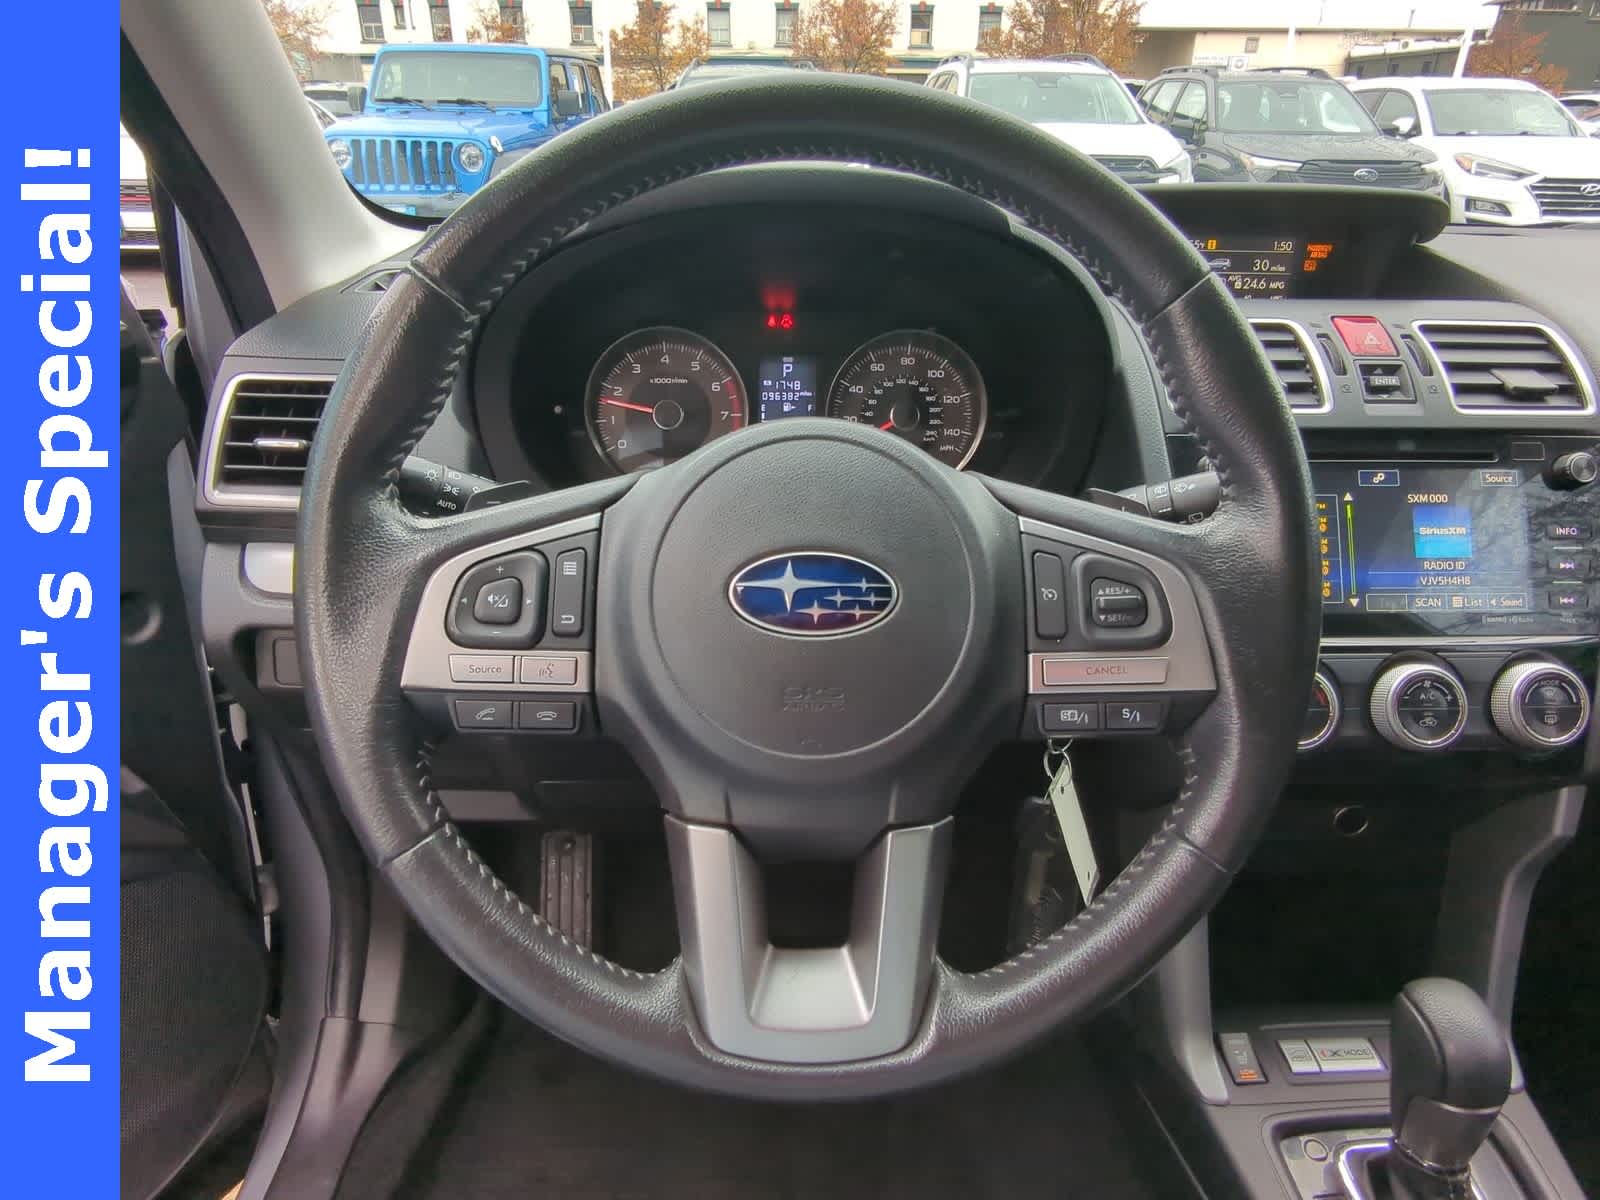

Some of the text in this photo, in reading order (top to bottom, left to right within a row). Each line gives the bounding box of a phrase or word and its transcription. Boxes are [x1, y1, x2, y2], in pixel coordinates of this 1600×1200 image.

[1274, 241, 1293, 251] 1:50
[1253, 259, 1286, 272] 30 miles
[1243, 277, 1286, 289] 24.6 MPG
[660, 354, 670, 364] 4
[900, 357, 916, 365] 80
[632, 363, 641, 374] 3
[691, 361, 701, 371] 5
[783, 363, 793, 377] P
[870, 363, 885, 371] 60
[927, 369, 945, 378] 100
[775, 380, 801, 391] 1748
[1375, 377, 1397, 385] ENTER
[613, 386, 623, 396] 2
[711, 382, 721, 392] 6
[848, 385, 864, 394] 40
[761, 391, 800, 401] 096382
[943, 394, 961, 404] 120
[720, 410, 729, 420] 7
[943, 428, 961, 436] 140
[617, 440, 627, 449] 0
[1485, 473, 1513, 483] Source
[1407, 494, 1449, 503] SXM 000
[437, 499, 457, 511] AUTO
[1556, 527, 1577, 535] INFO
[1423, 561, 1465, 570] RADIO ID
[1415, 598, 1442, 607] SCAN
[1464, 597, 1483, 607] List
[1499, 597, 1522, 607] Sound
[468, 664, 502, 674] Source
[1086, 665, 1129, 676] CANCEL
